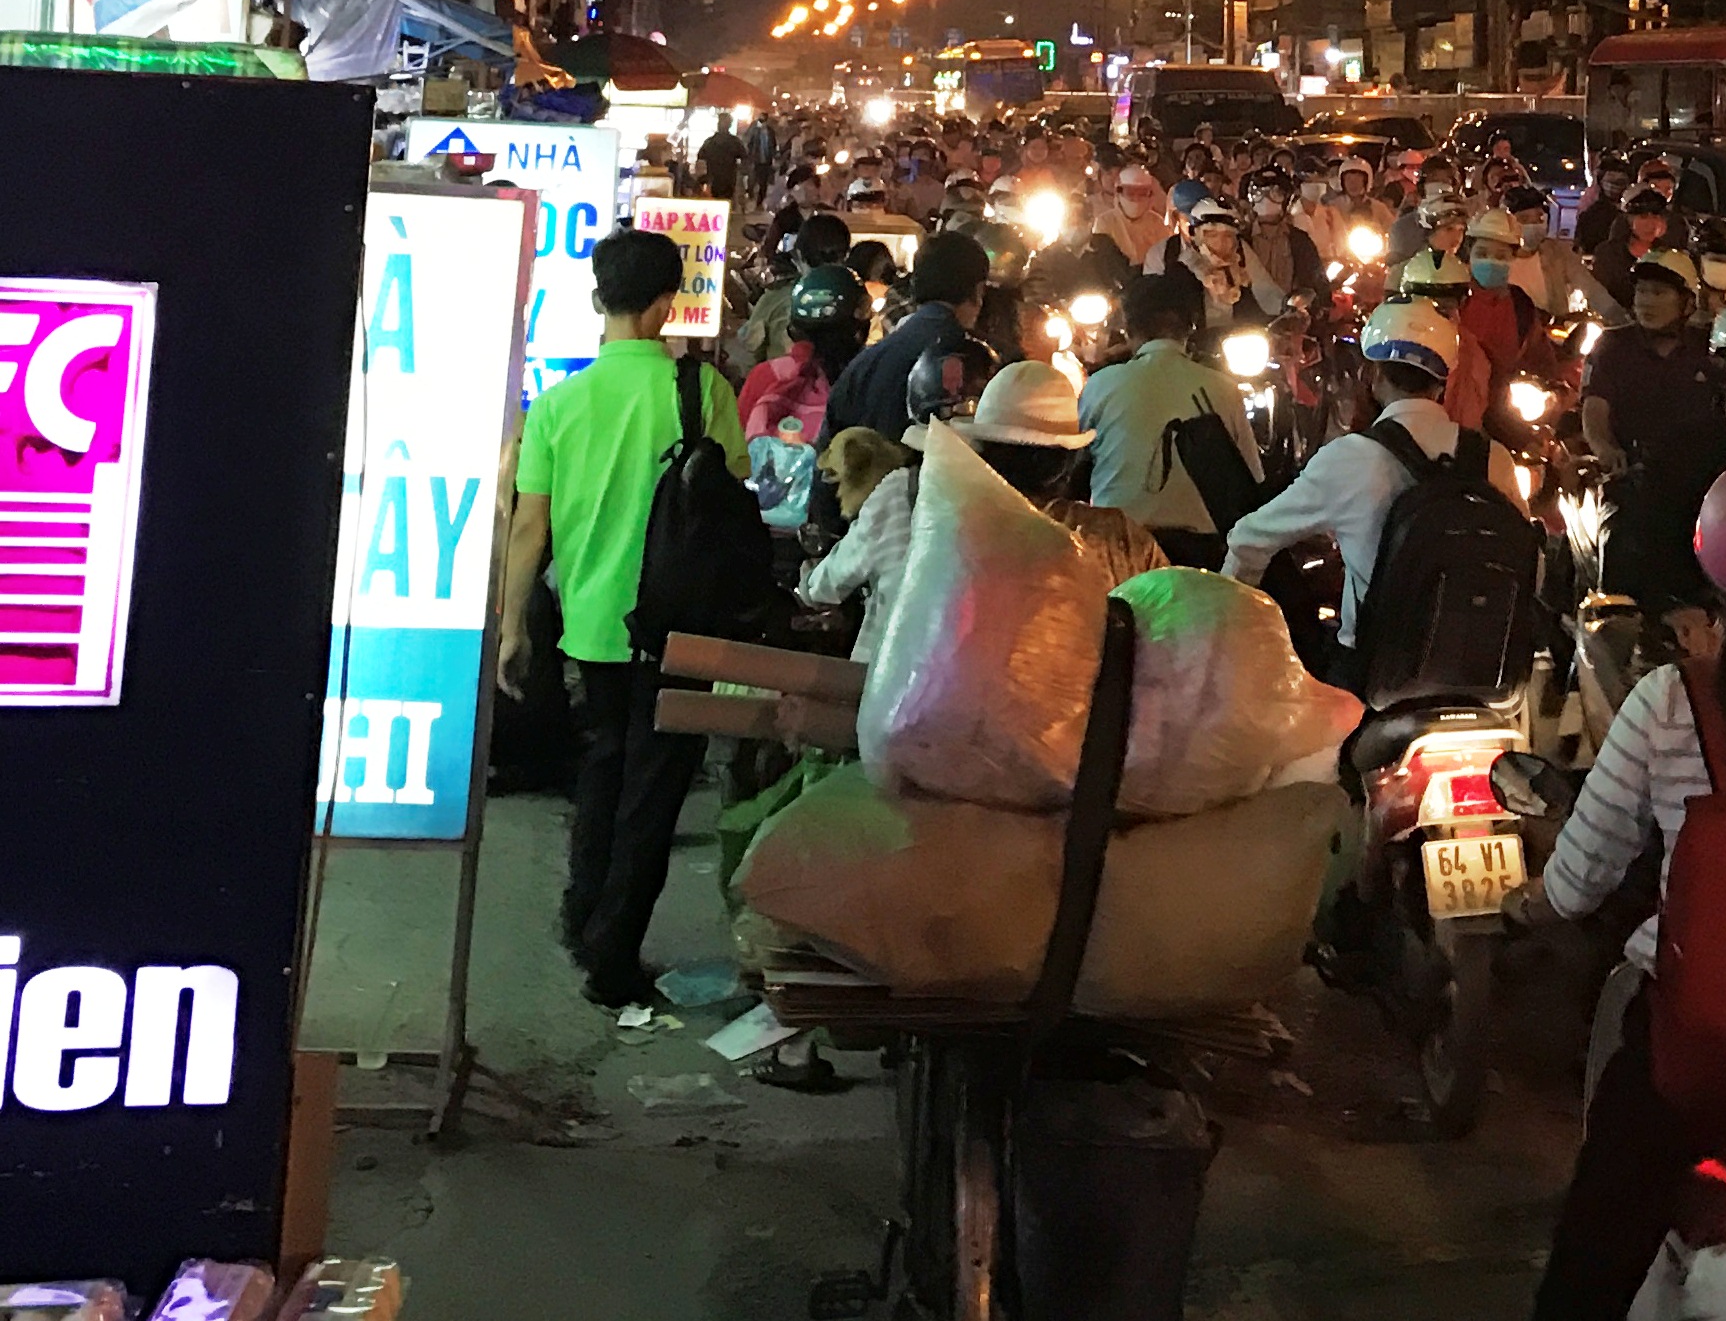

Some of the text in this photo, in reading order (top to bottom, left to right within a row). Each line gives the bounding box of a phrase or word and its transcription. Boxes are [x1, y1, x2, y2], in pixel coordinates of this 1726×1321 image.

[508, 136, 582, 172] NHÀ
[695, 241, 726, 266] LỘN
[683, 307, 711, 324] ME
[343, 439, 481, 599] ÂY
[1437, 841, 1507, 877] 64 V1
